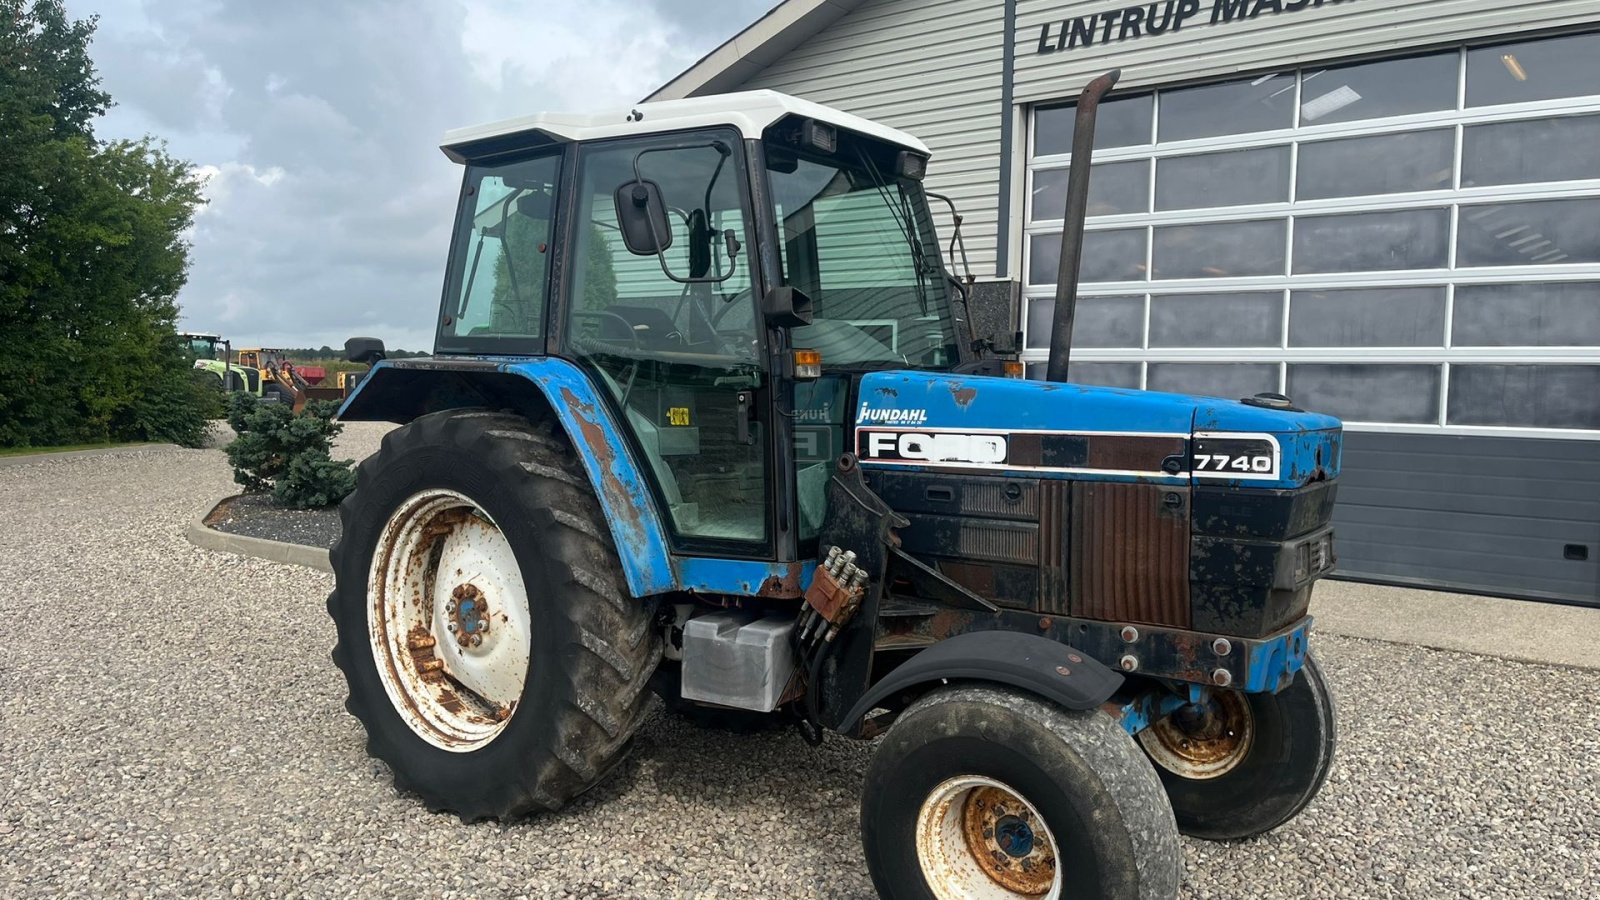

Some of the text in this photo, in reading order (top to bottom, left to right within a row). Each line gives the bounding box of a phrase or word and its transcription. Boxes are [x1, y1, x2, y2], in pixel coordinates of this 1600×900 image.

[1037, 0, 1200, 54] LINTRUP
[869, 432, 1007, 462] FOD
[1194, 454, 1271, 472] 7740
